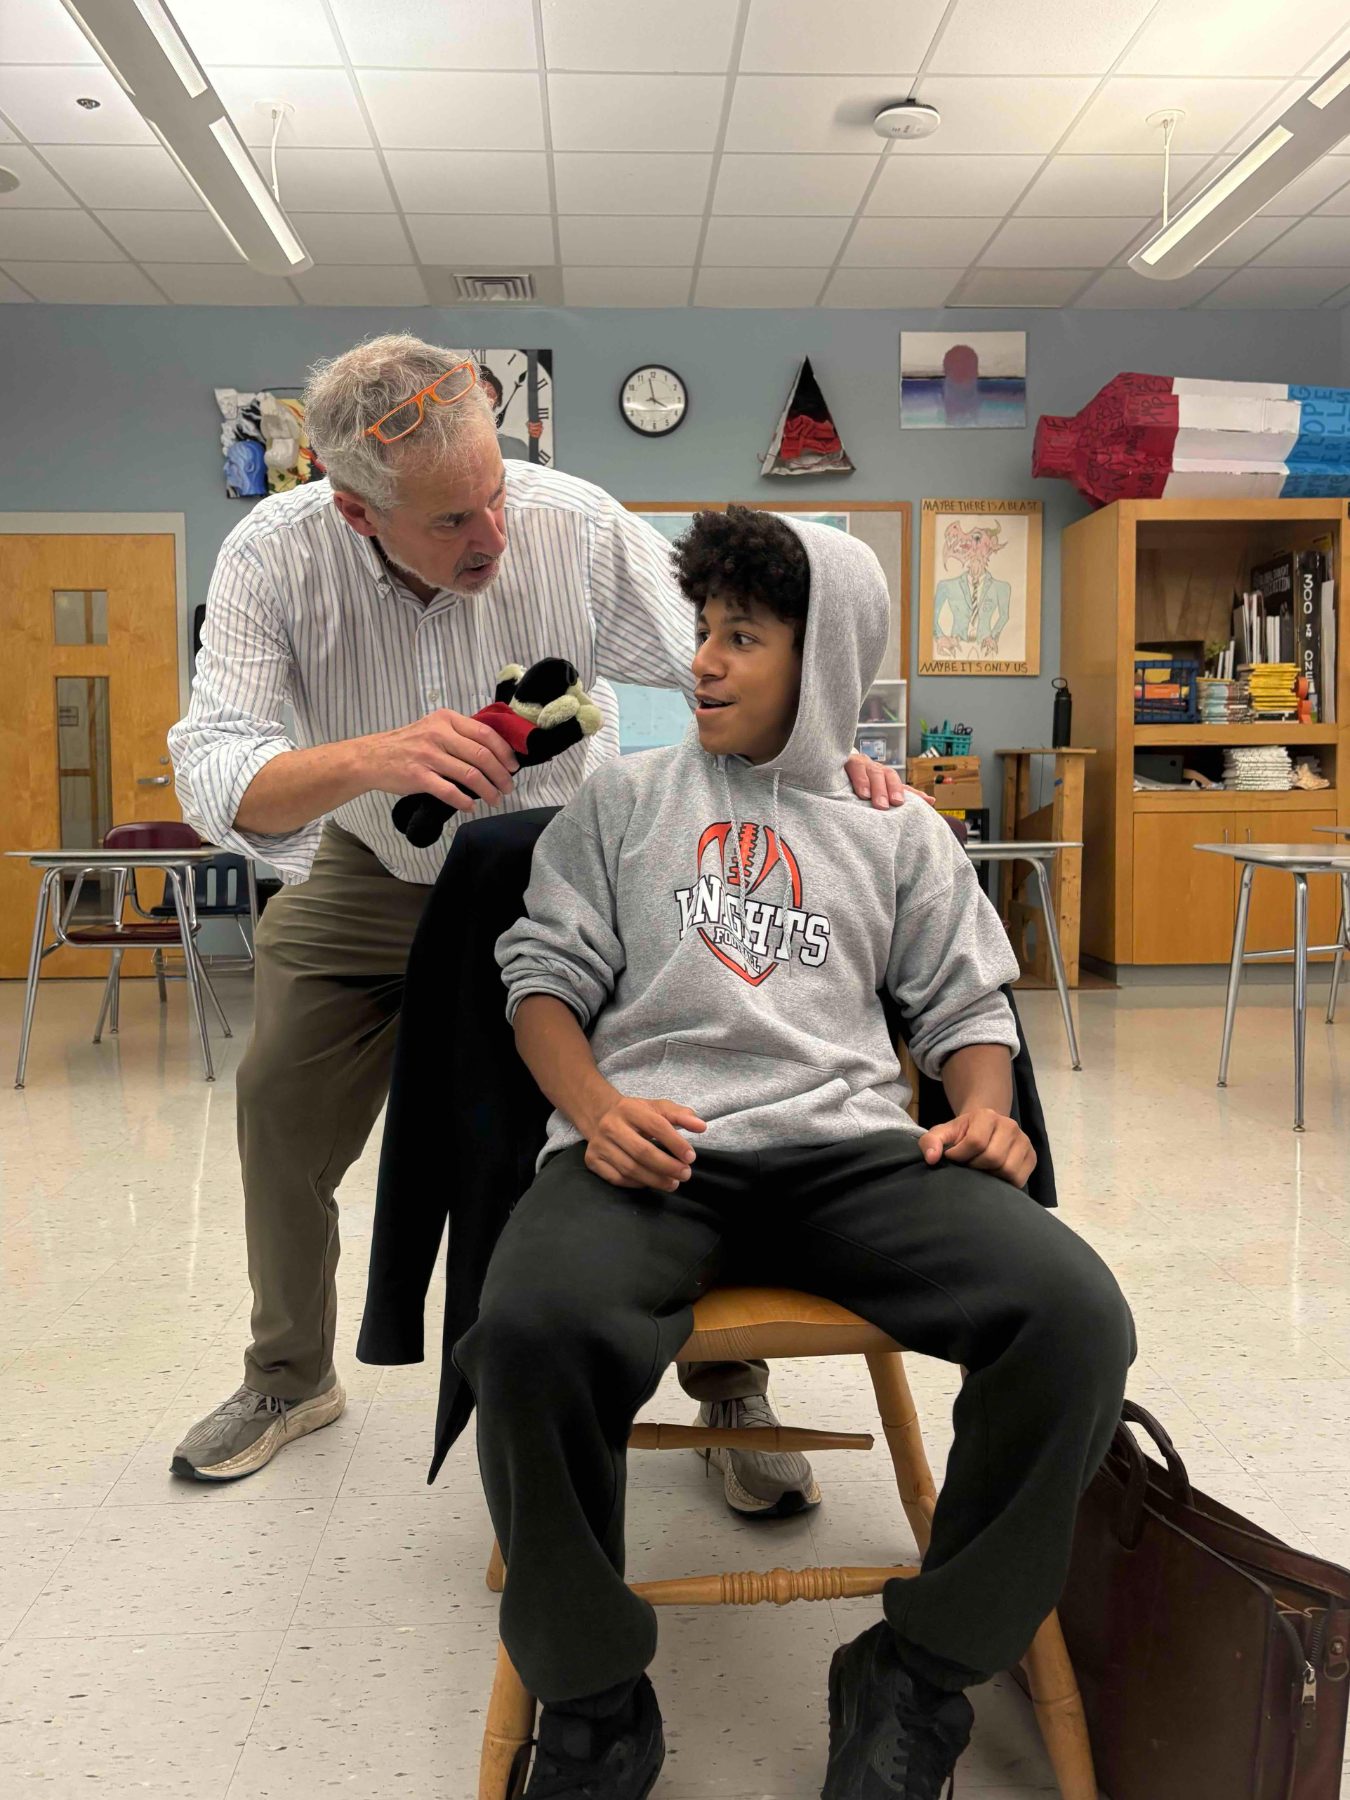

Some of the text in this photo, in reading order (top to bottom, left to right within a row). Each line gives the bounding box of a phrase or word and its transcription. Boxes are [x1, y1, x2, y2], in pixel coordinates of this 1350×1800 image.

[922, 500, 1037, 512] MAYBE THERE IS A BEAST
[1303, 573, 1314, 615] 300
[920, 662, 958, 673] MAYBE
[984, 662, 1010, 673] ONLY
[1014, 662, 1029, 674] US
